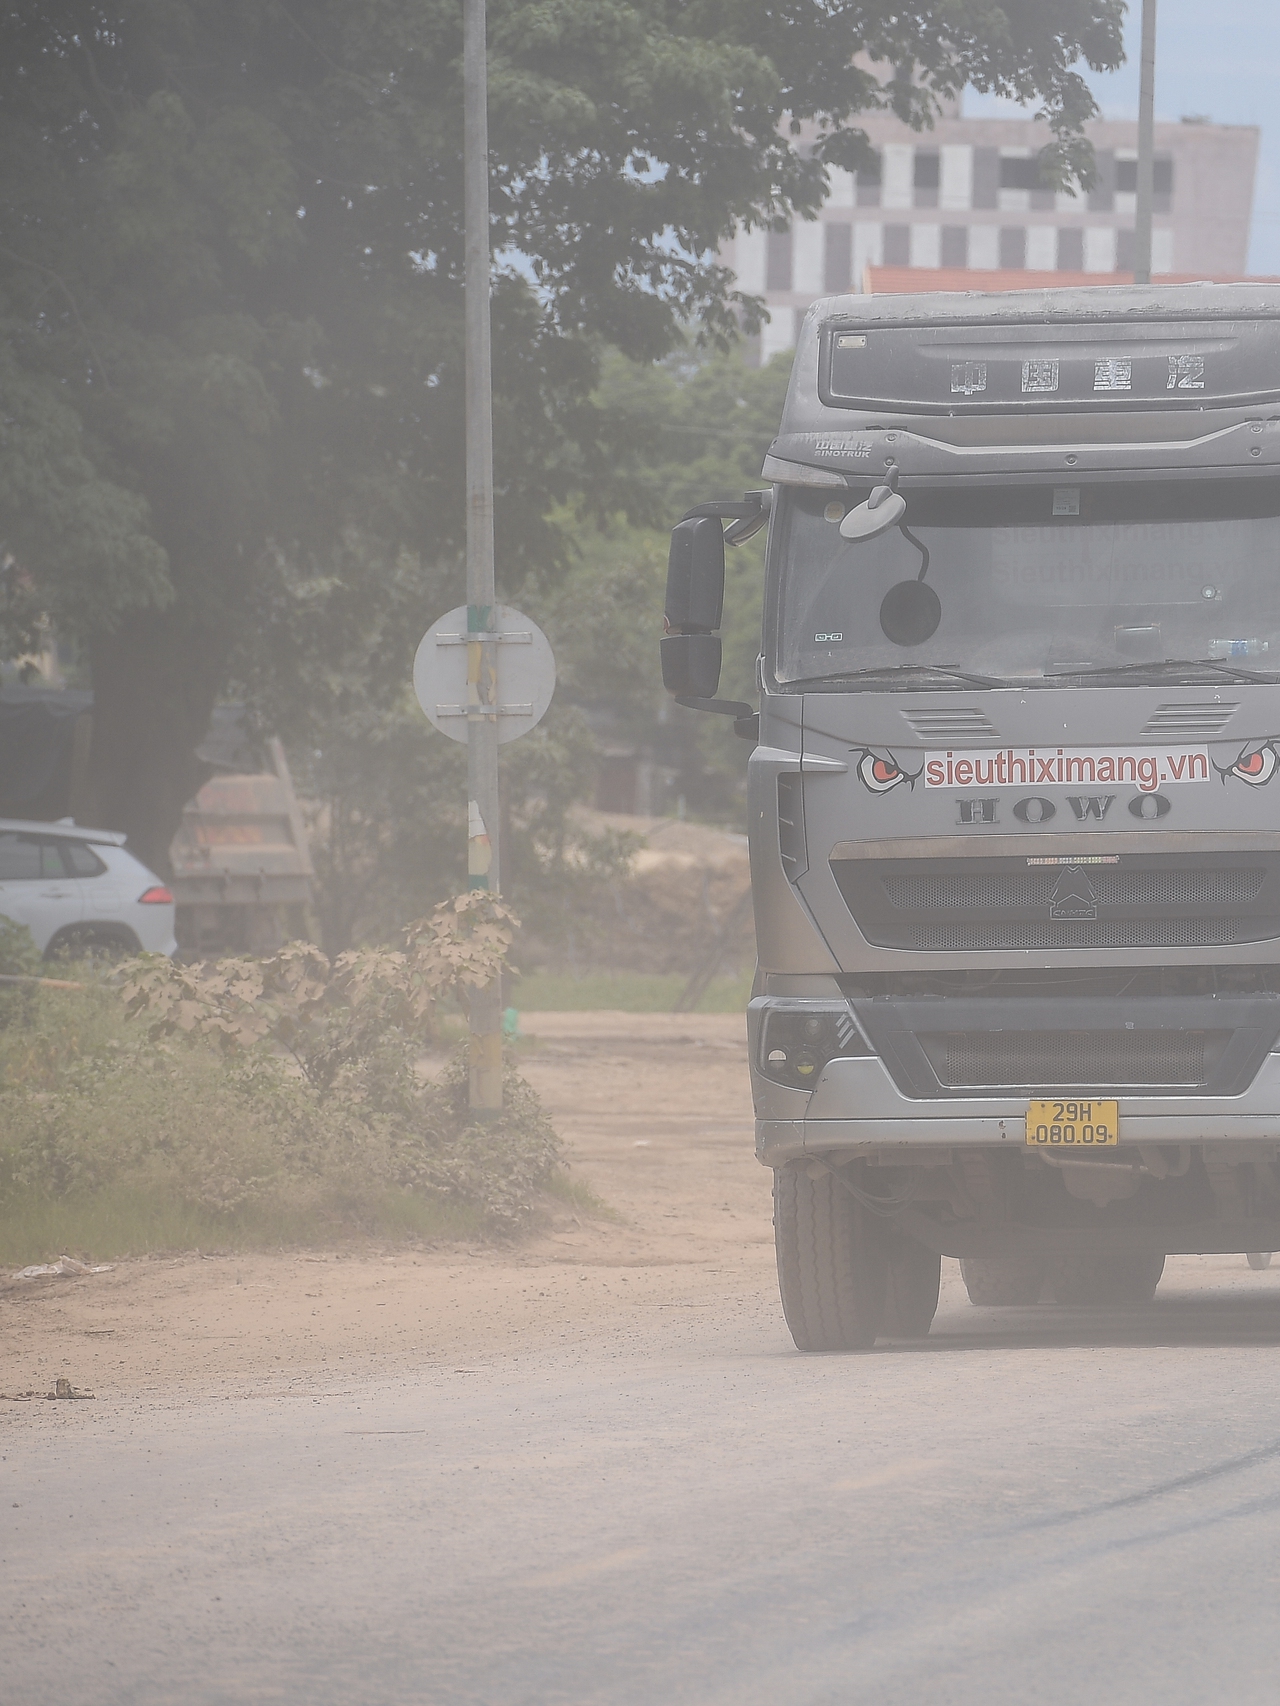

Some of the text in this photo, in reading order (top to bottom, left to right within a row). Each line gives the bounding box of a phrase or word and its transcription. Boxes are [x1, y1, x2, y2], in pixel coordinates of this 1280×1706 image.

[814, 450, 870, 458] SINOTRUK
[926, 748, 1208, 791] sieuthiximang.vn
[955, 792, 1172, 825] HOWO
[1052, 1102, 1092, 1122] 29H
[1036, 1124, 1108, 1143] 080.09
